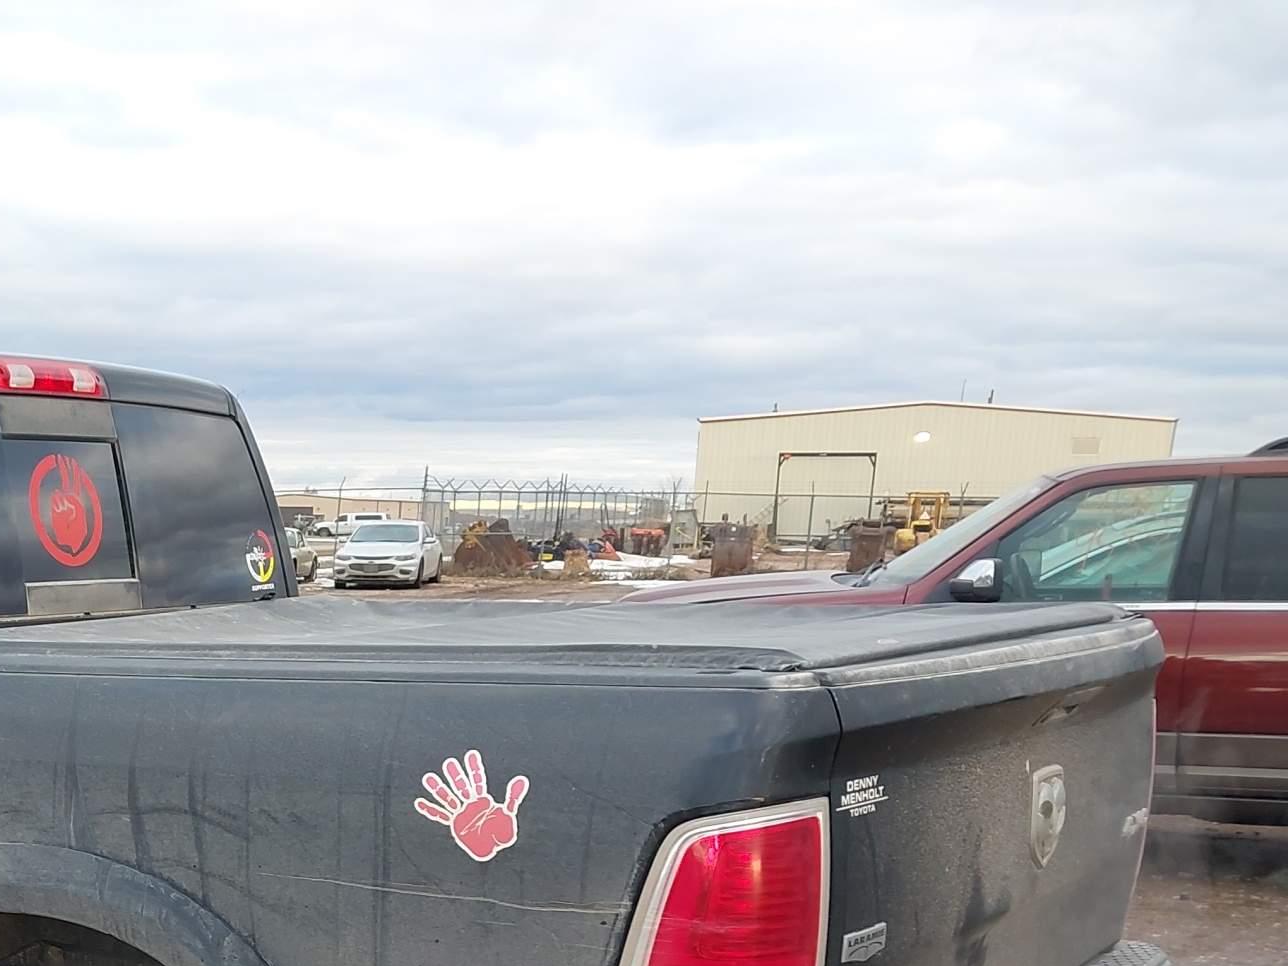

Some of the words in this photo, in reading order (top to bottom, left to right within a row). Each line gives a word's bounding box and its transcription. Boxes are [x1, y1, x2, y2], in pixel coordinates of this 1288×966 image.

[846, 774, 879, 793] DENNY
[841, 785, 885, 806] MENHOLT
[849, 804, 876, 817] TOYOTA
